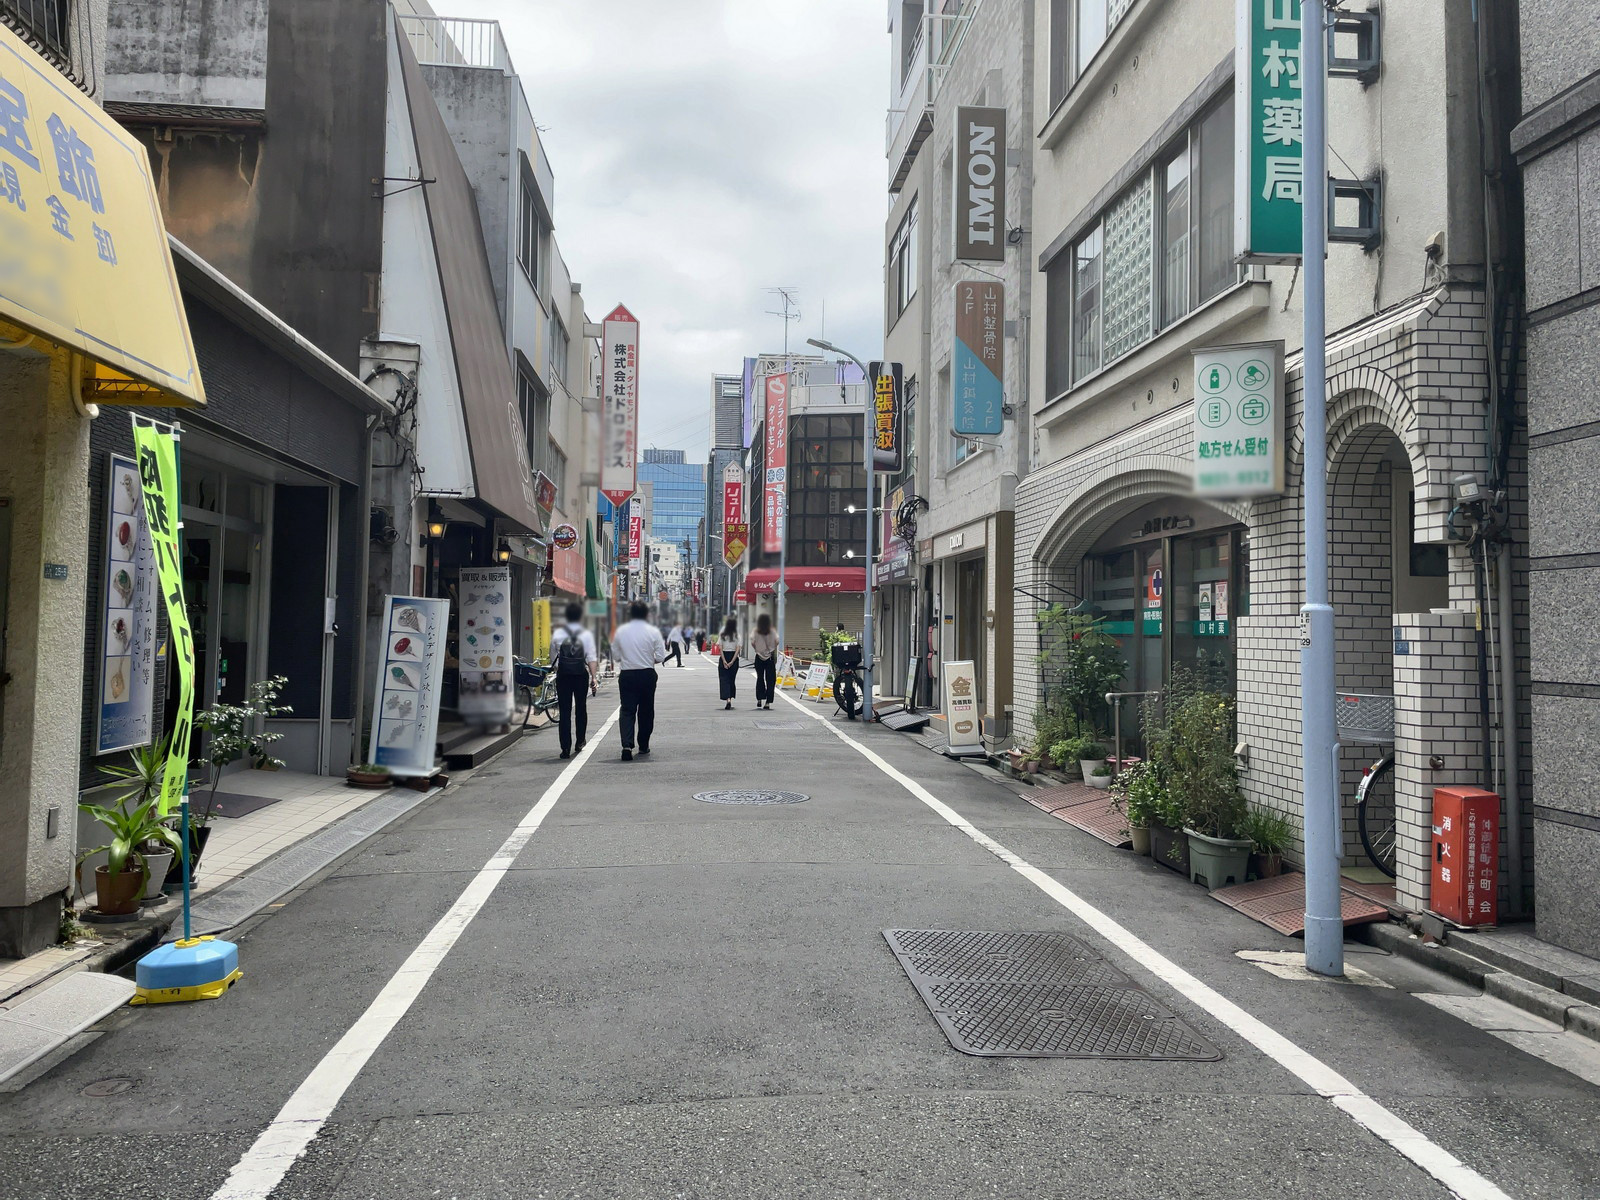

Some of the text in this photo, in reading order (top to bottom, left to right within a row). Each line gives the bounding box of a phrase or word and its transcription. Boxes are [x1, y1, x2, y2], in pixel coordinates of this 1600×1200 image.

[968, 122, 996, 246] IMON
[983, 287, 997, 360] 山村整骨院
[767, 404, 775, 466] ダイヤモンド
[876, 375, 893, 450] 出張買取
[1198, 436, 1269, 460] 処方せん受付
[610, 490, 625, 498] 買取
[629, 518, 639, 553] リューツウ
[727, 525, 746, 533] 激安
[951, 676, 972, 697] 金
[1442, 815, 1452, 883] 消火器
